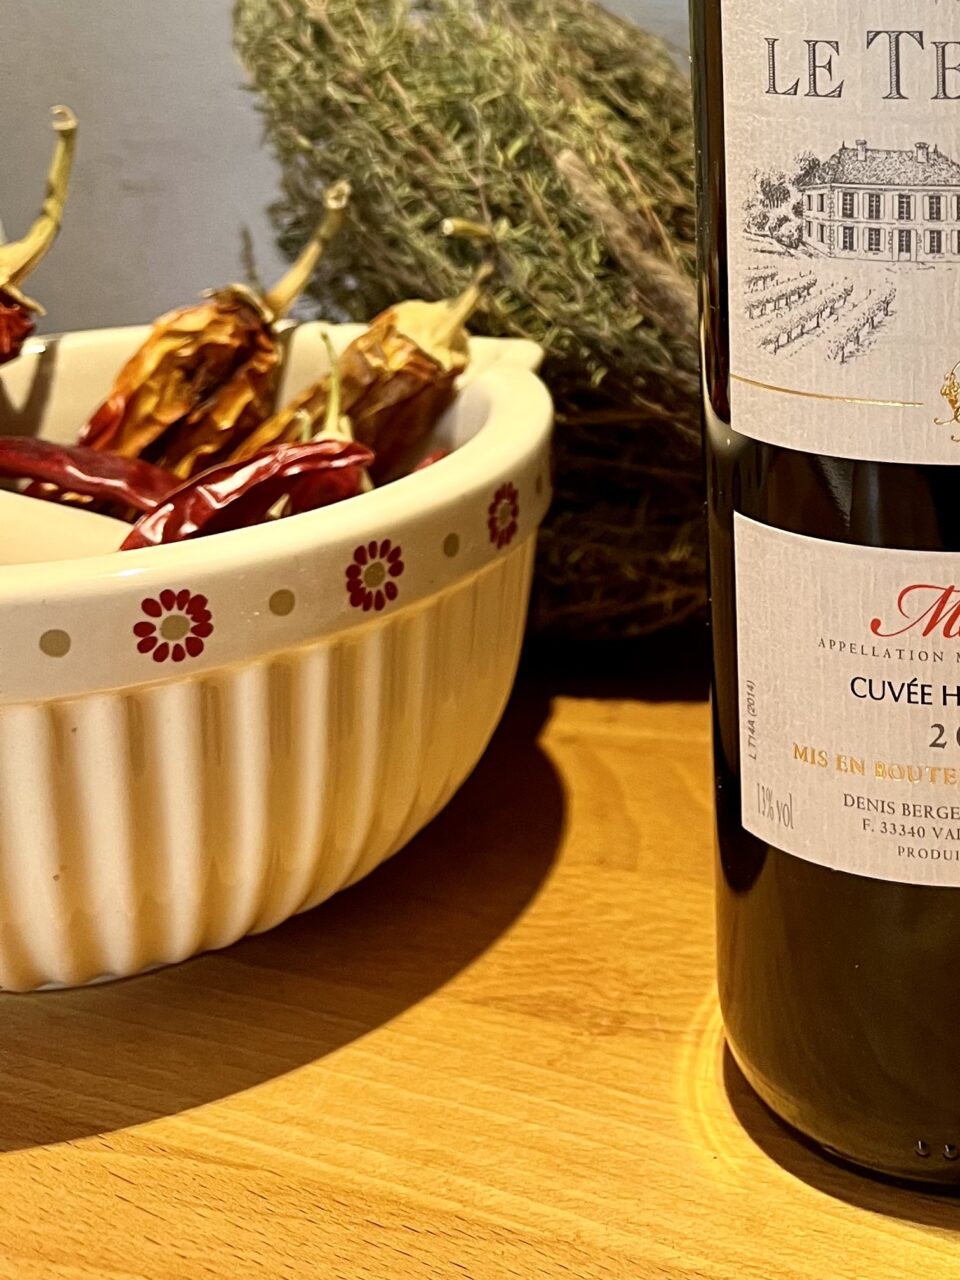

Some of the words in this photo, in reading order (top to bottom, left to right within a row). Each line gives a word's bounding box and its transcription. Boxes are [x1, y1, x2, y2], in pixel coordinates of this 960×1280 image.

[764, 37, 845, 99] LE
[818, 637, 945, 663] APPELLATION
[747, 680, 757, 717] (2014)
[850, 676, 933, 706] CUVÉE
[792, 742, 829, 768] MIS
[835, 754, 866, 776] EN
[756, 782, 775, 823] 13%
[776, 793, 795, 830] vol
[843, 793, 896, 815] DENIS
[862, 819, 876, 832] F.
[880, 820, 926, 839] 33340
